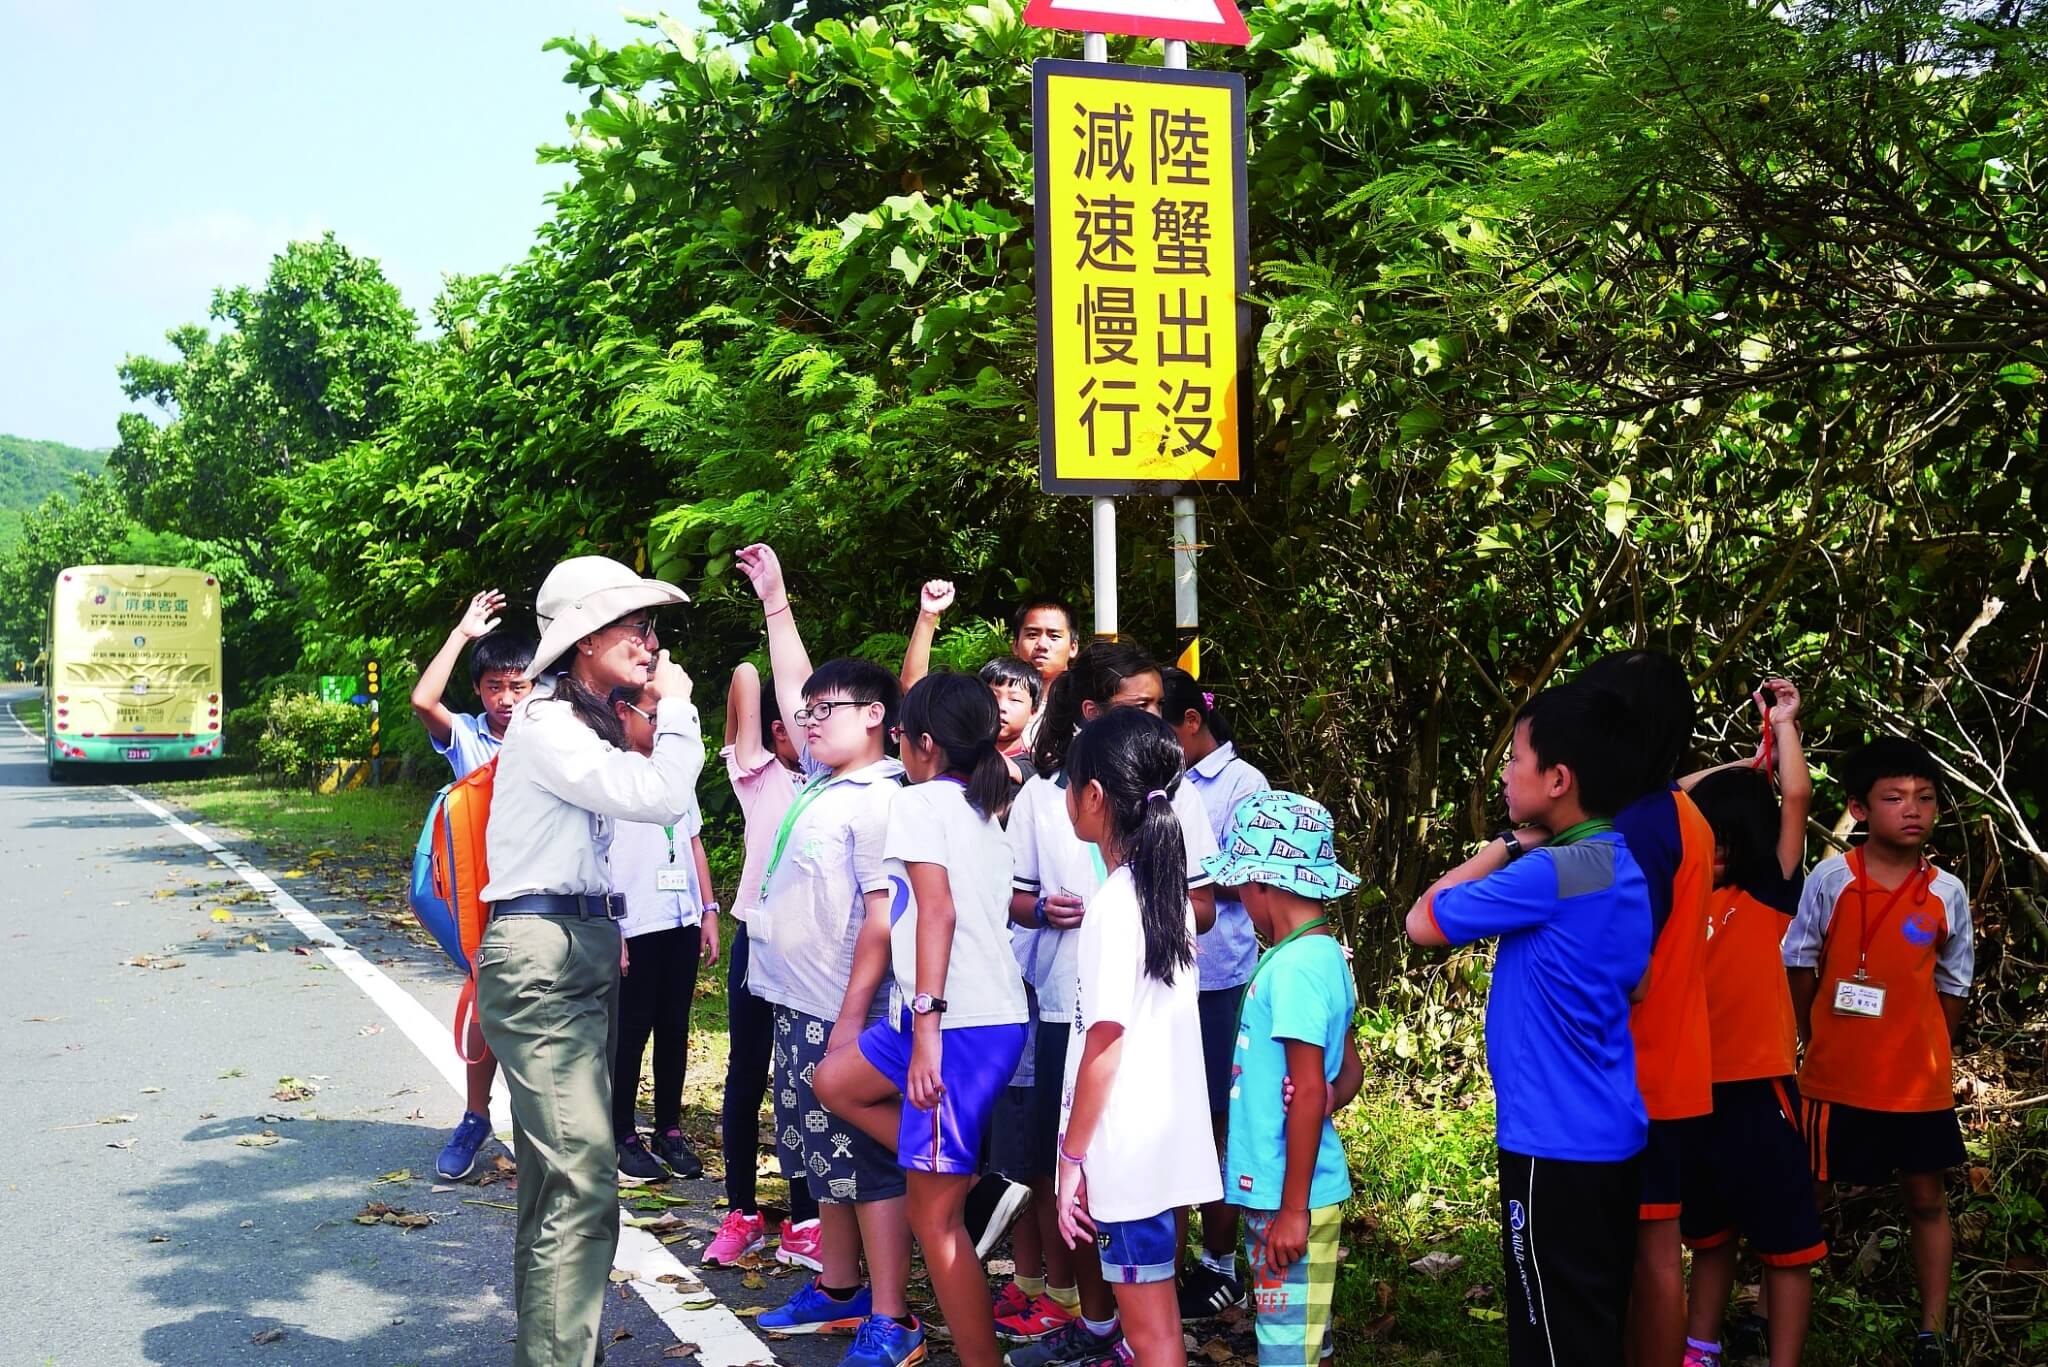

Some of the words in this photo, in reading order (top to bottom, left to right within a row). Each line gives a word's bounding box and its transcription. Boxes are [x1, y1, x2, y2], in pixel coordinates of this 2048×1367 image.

[1073, 102, 1140, 458] 減速慢行
[1150, 107, 1217, 459] 陸蟹出沒
[125, 598, 189, 613] 屏東客運
